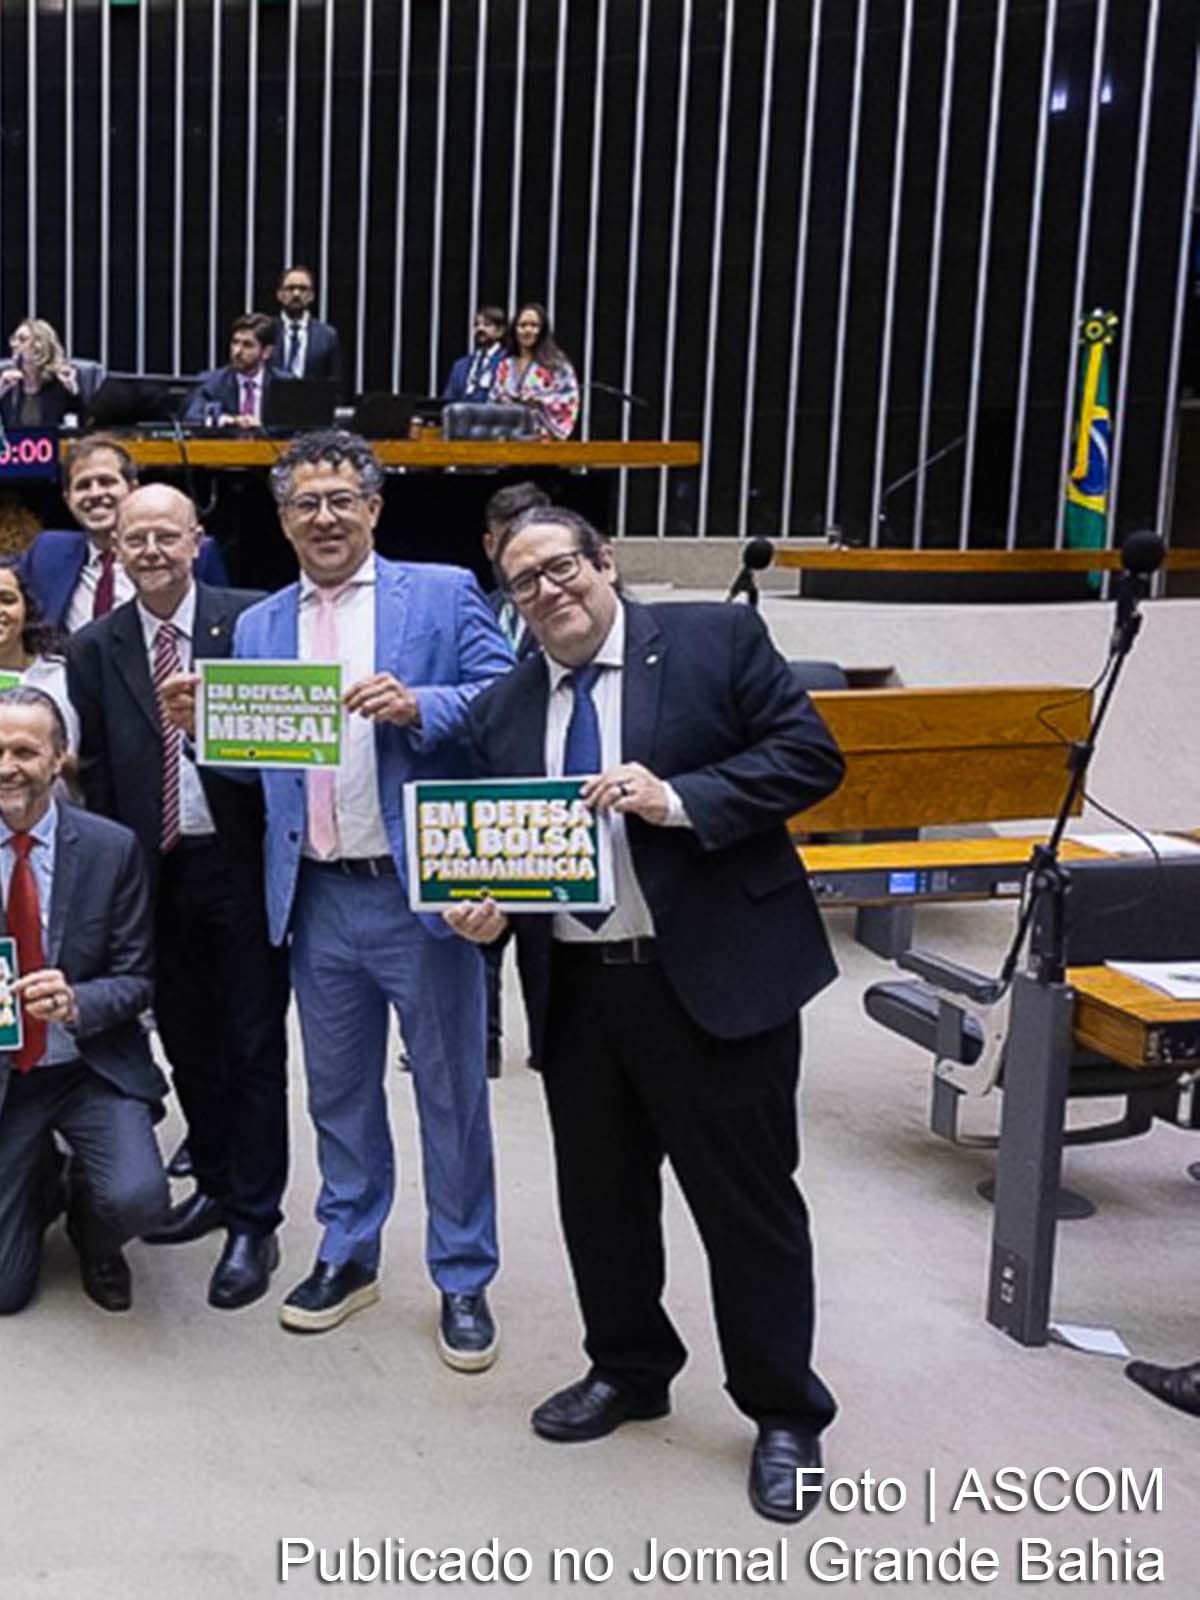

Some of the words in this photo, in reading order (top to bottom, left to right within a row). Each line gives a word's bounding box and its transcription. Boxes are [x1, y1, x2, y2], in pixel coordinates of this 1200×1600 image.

[208, 683, 234, 698] EM
[238, 683, 305, 701] DEFESA
[310, 685, 337, 701] DA
[208, 714, 337, 743] MENSAL
[420, 802, 467, 829] EM
[472, 799, 593, 830] DEFESA
[420, 828, 471, 857] DA
[476, 827, 595, 858] BOLSA
[422, 856, 596, 881] PERMANÊNCIA
